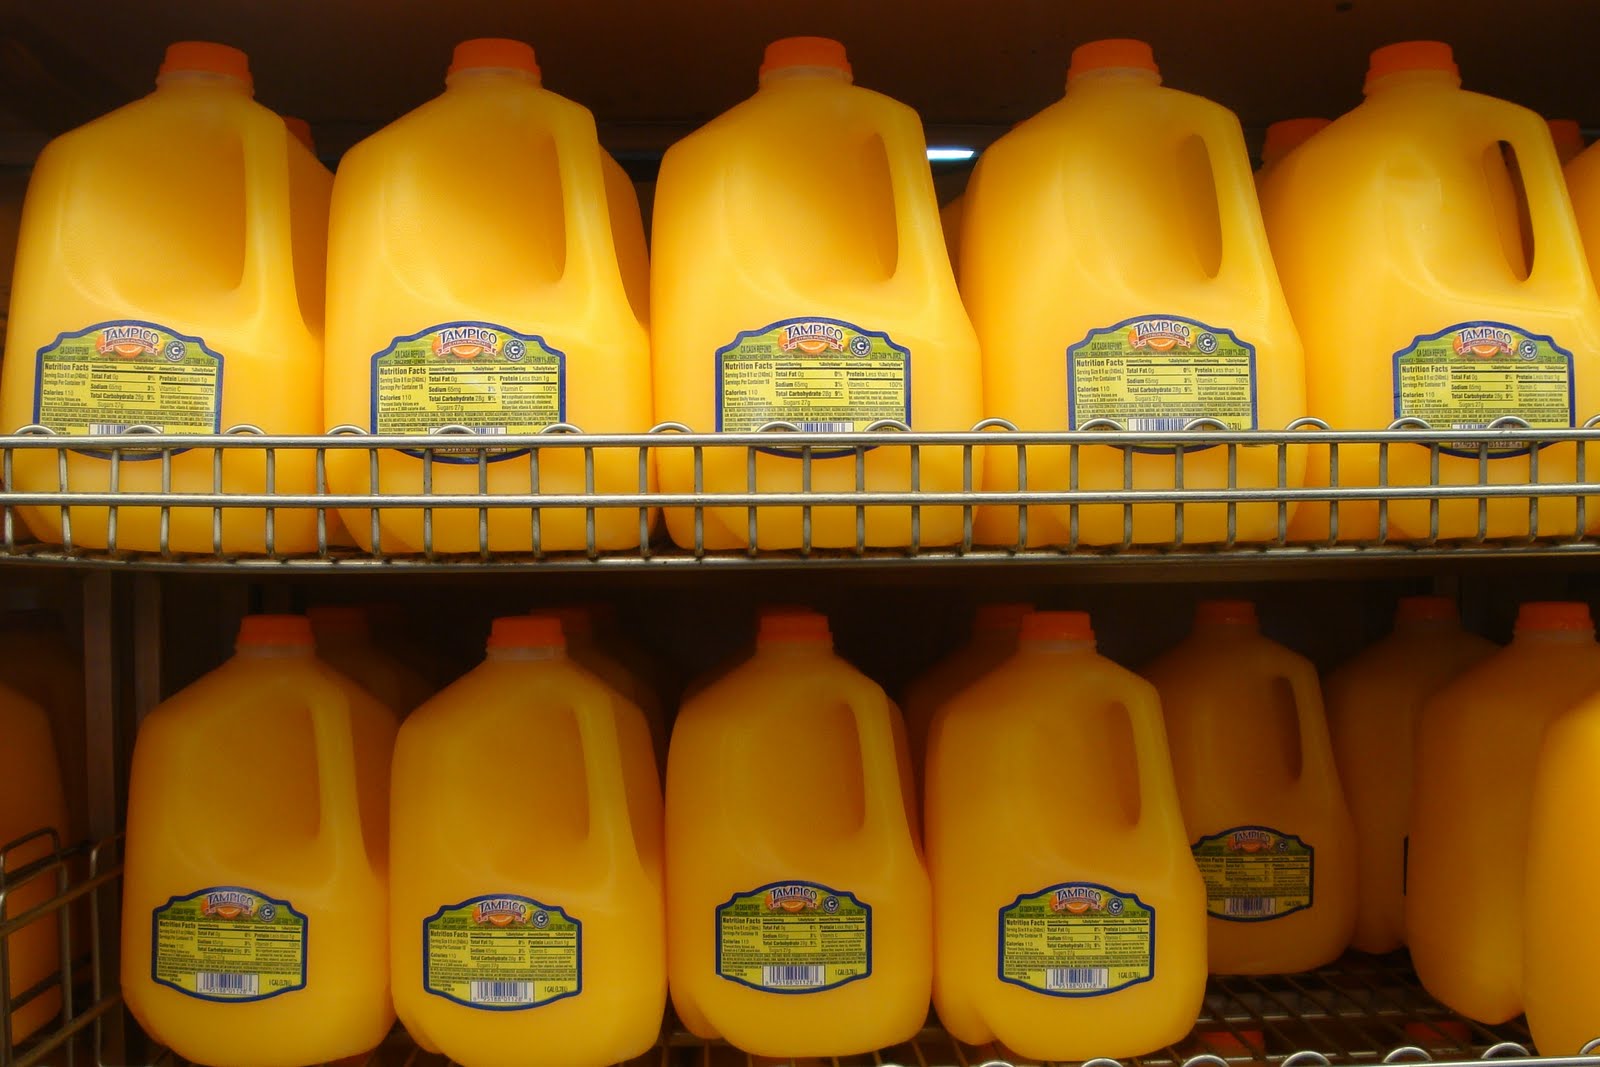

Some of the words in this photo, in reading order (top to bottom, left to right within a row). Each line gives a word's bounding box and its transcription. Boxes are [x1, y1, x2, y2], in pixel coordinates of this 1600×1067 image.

[102, 327, 159, 344] TAMPICO
[439, 329, 497, 344] TAMPICO
[784, 324, 843, 340] TAMPICO
[1133, 322, 1190, 337] TAMPICO
[1458, 328, 1512, 344] TAMPICO
[1105, 359, 1123, 367] Facts
[770, 887, 817, 900] TAMPICO
[1055, 888, 1102, 901] TAMPICO
[478, 900, 526, 914] TAMPICO
